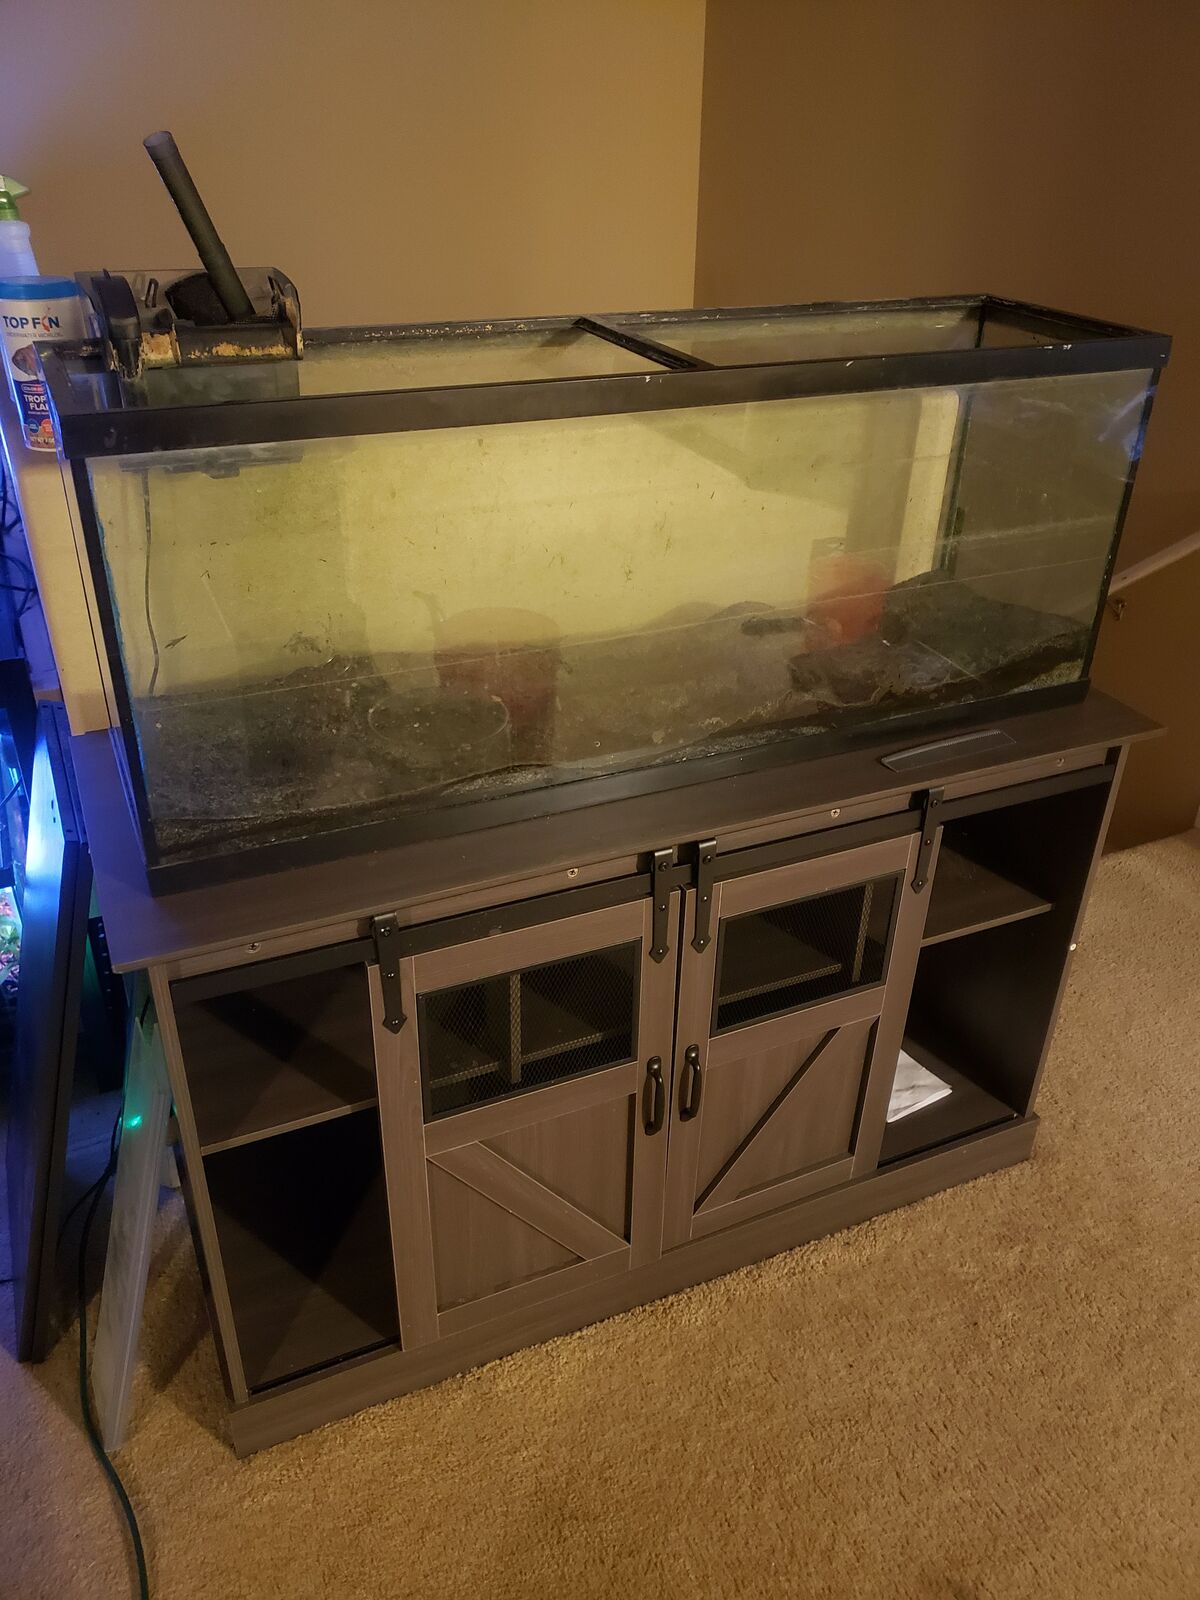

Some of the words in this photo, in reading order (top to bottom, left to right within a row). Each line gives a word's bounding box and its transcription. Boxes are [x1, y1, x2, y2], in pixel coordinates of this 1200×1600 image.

[3, 315, 29, 329] TOP
[32, 314, 60, 332] FIN
[24, 394, 48, 403] TROP
